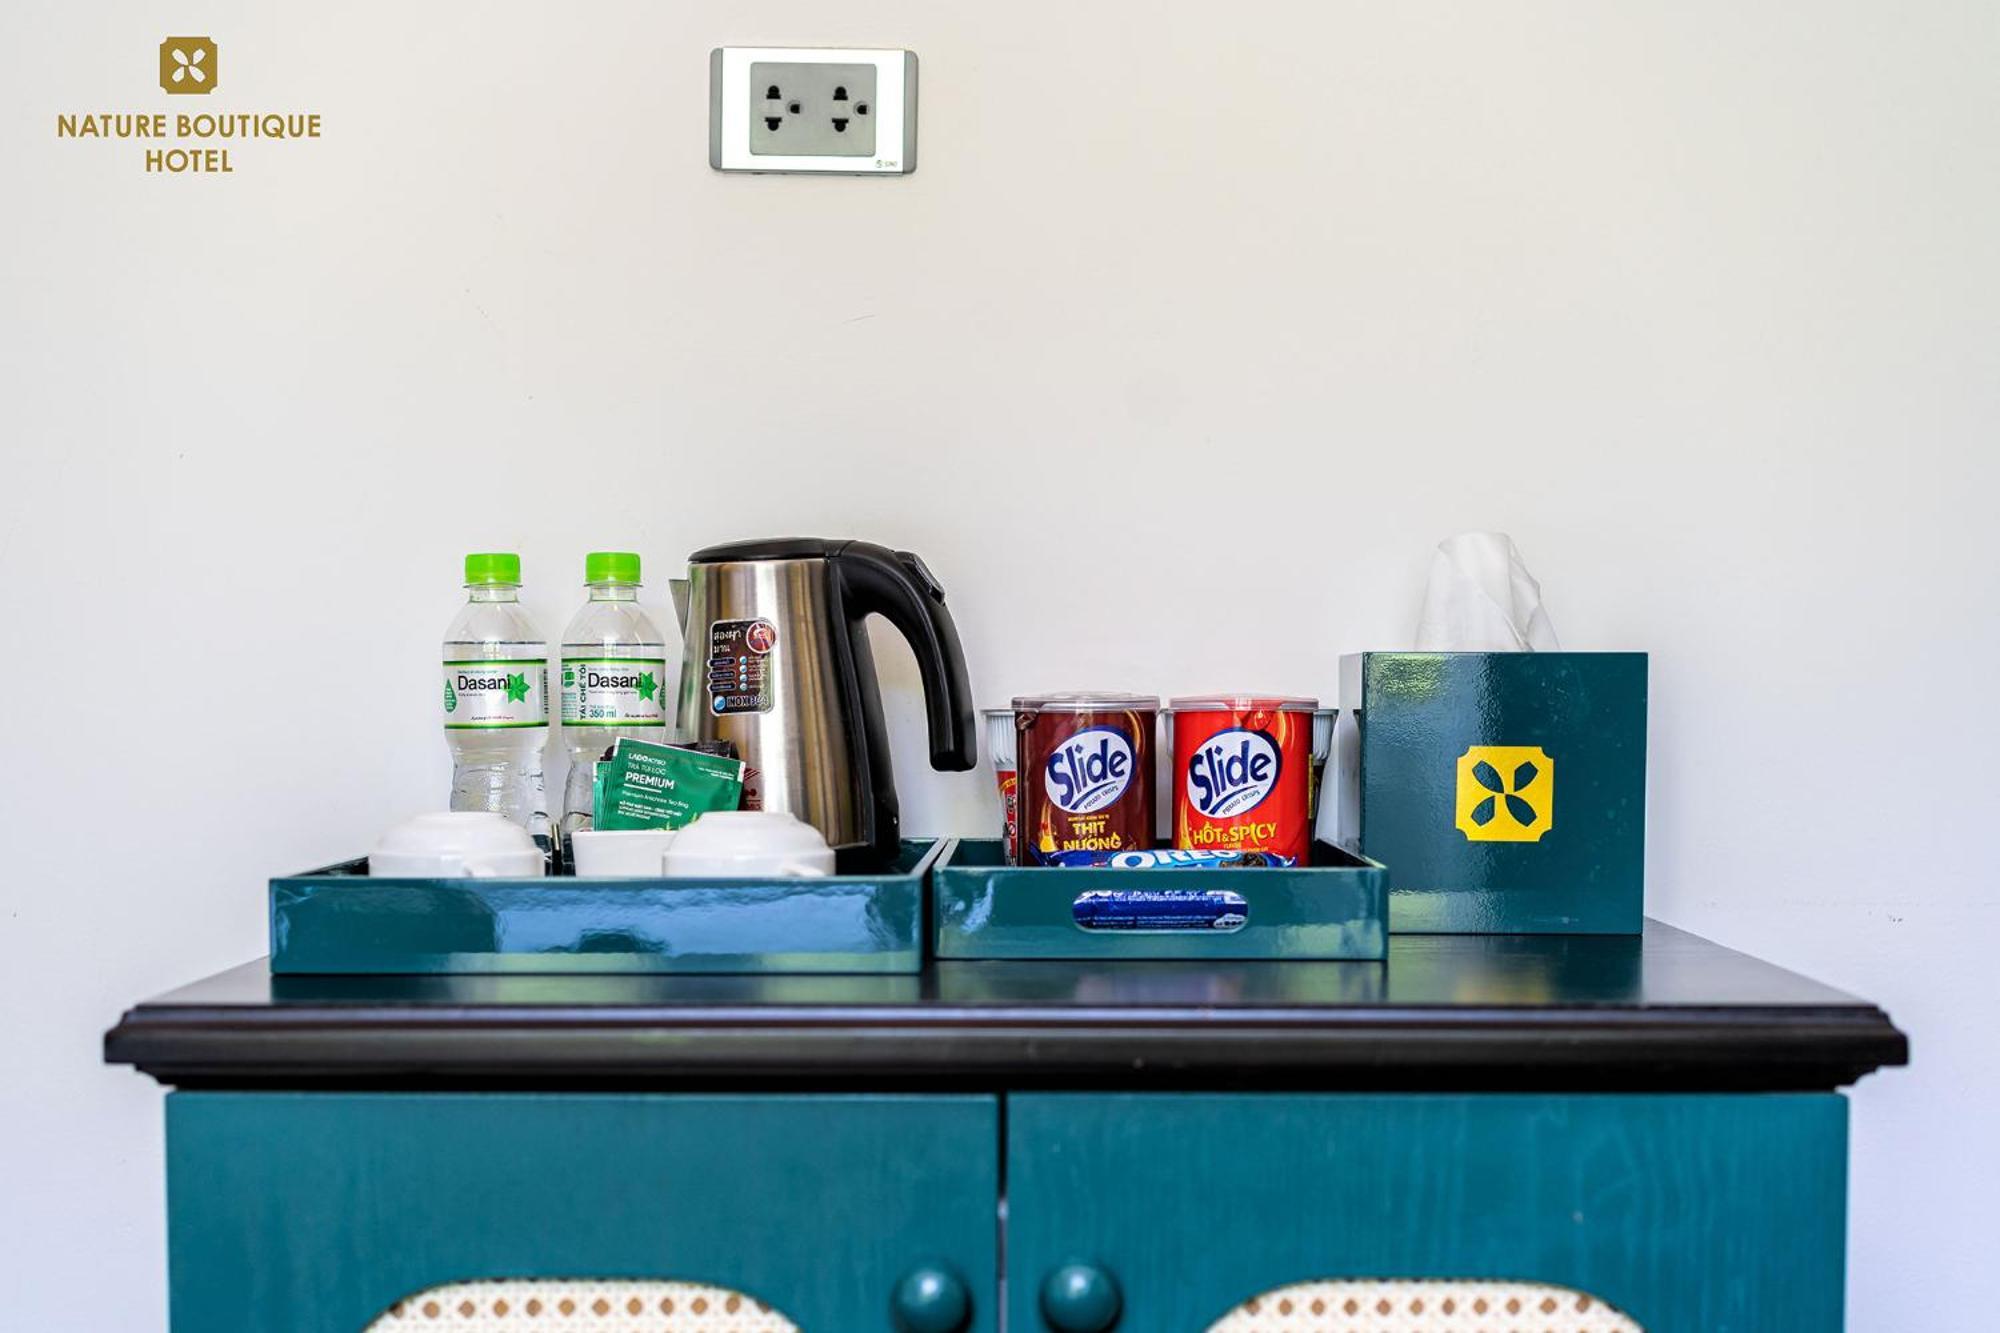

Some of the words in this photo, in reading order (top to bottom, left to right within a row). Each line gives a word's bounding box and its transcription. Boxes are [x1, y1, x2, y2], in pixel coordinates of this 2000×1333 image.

[458, 674, 510, 690] Dasani
[588, 672, 642, 688] Dasani
[589, 709, 605, 718] 350
[606, 709, 617, 718] ml
[625, 772, 675, 790] PREMIUM
[1047, 738, 1128, 807] Slide
[1189, 740, 1272, 811] Slide
